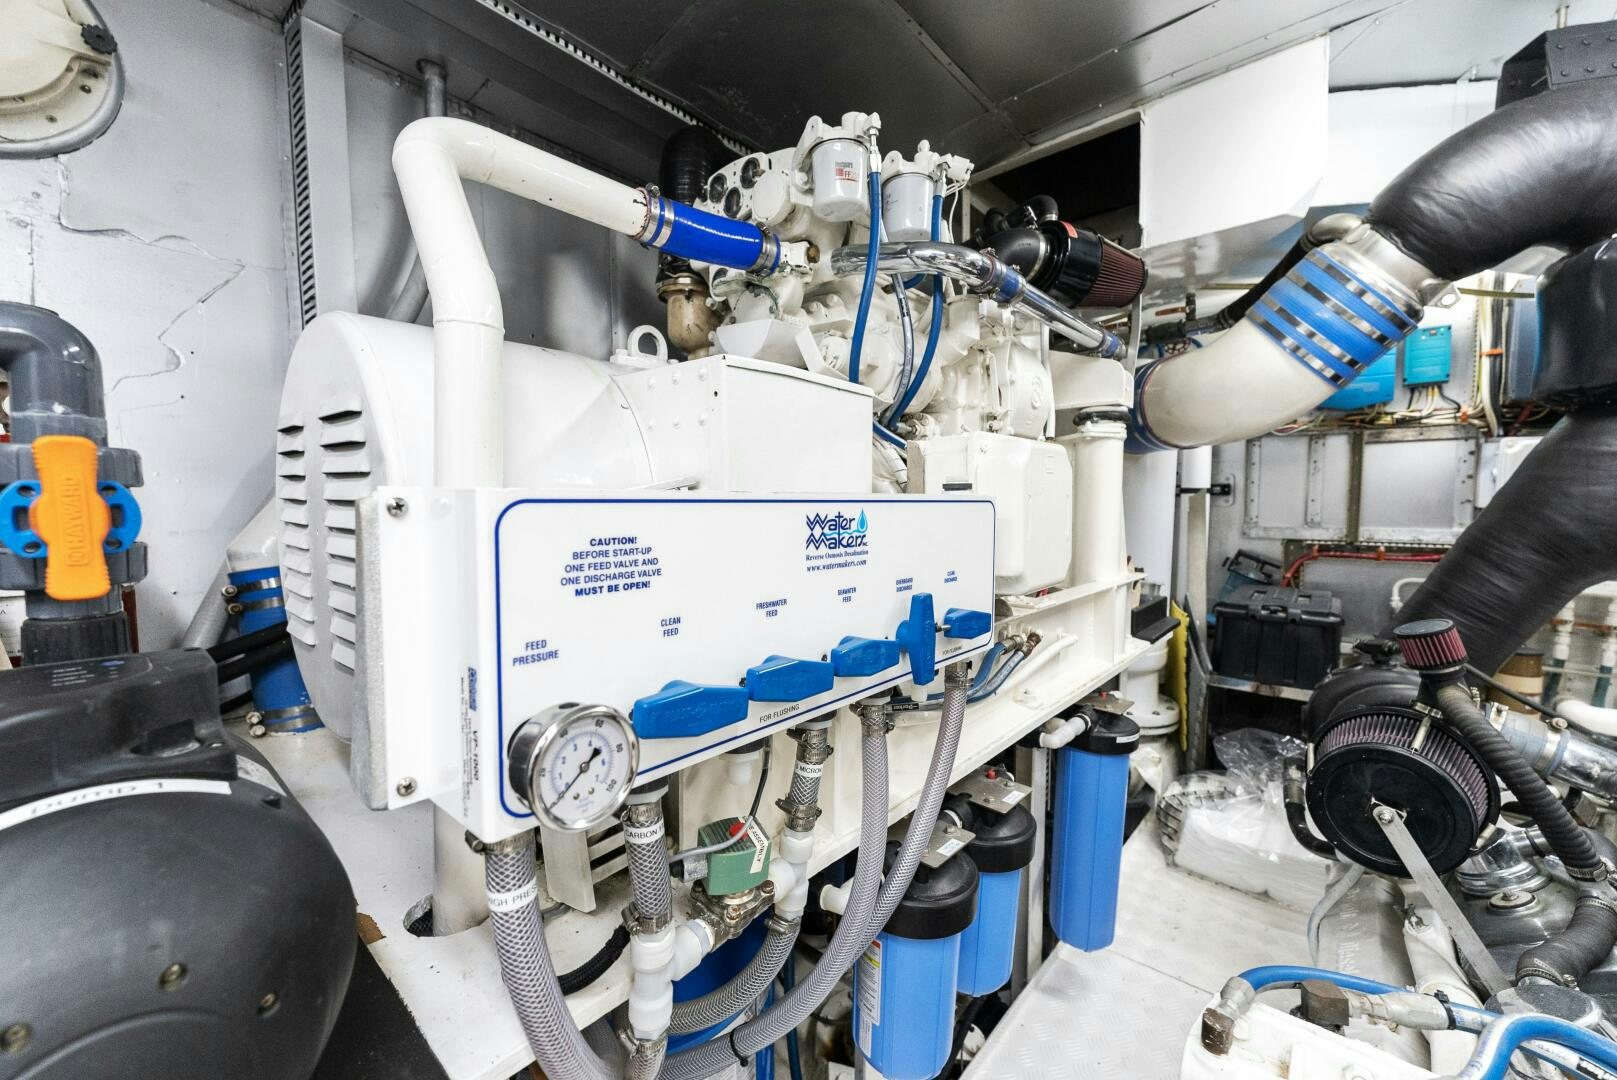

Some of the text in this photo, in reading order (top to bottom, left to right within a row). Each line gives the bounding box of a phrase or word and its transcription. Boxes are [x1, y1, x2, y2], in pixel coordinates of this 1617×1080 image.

[62, 475, 86, 549] HAYWARD
[806, 511, 855, 532] Water
[589, 536, 638, 547] CAUTION!
[805, 532, 866, 550] Makers
[572, 547, 653, 560] BEFORE START-UP
[564, 557, 659, 573] ONE FEED VALVE AND
[806, 559, 867, 573] www.watermakers.com
[560, 568, 662, 586] ONE DISCHARGE VALVE
[575, 580, 651, 597] MUST BE OPEN!
[837, 587, 857, 596] SEAWATER
[756, 598, 788, 610] FRESHWATER
[765, 609, 779, 618] FEED
[660, 616, 681, 627] CLEAN
[662, 627, 679, 638] FEED
[525, 639, 547, 651] FEED
[512, 649, 560, 667] PRESSURE
[759, 711, 772, 723] FOR
[773, 703, 800, 719] FLUSHING
[624, 828, 658, 840] CARBON
[752, 830, 765, 862] ASSEMBLY
